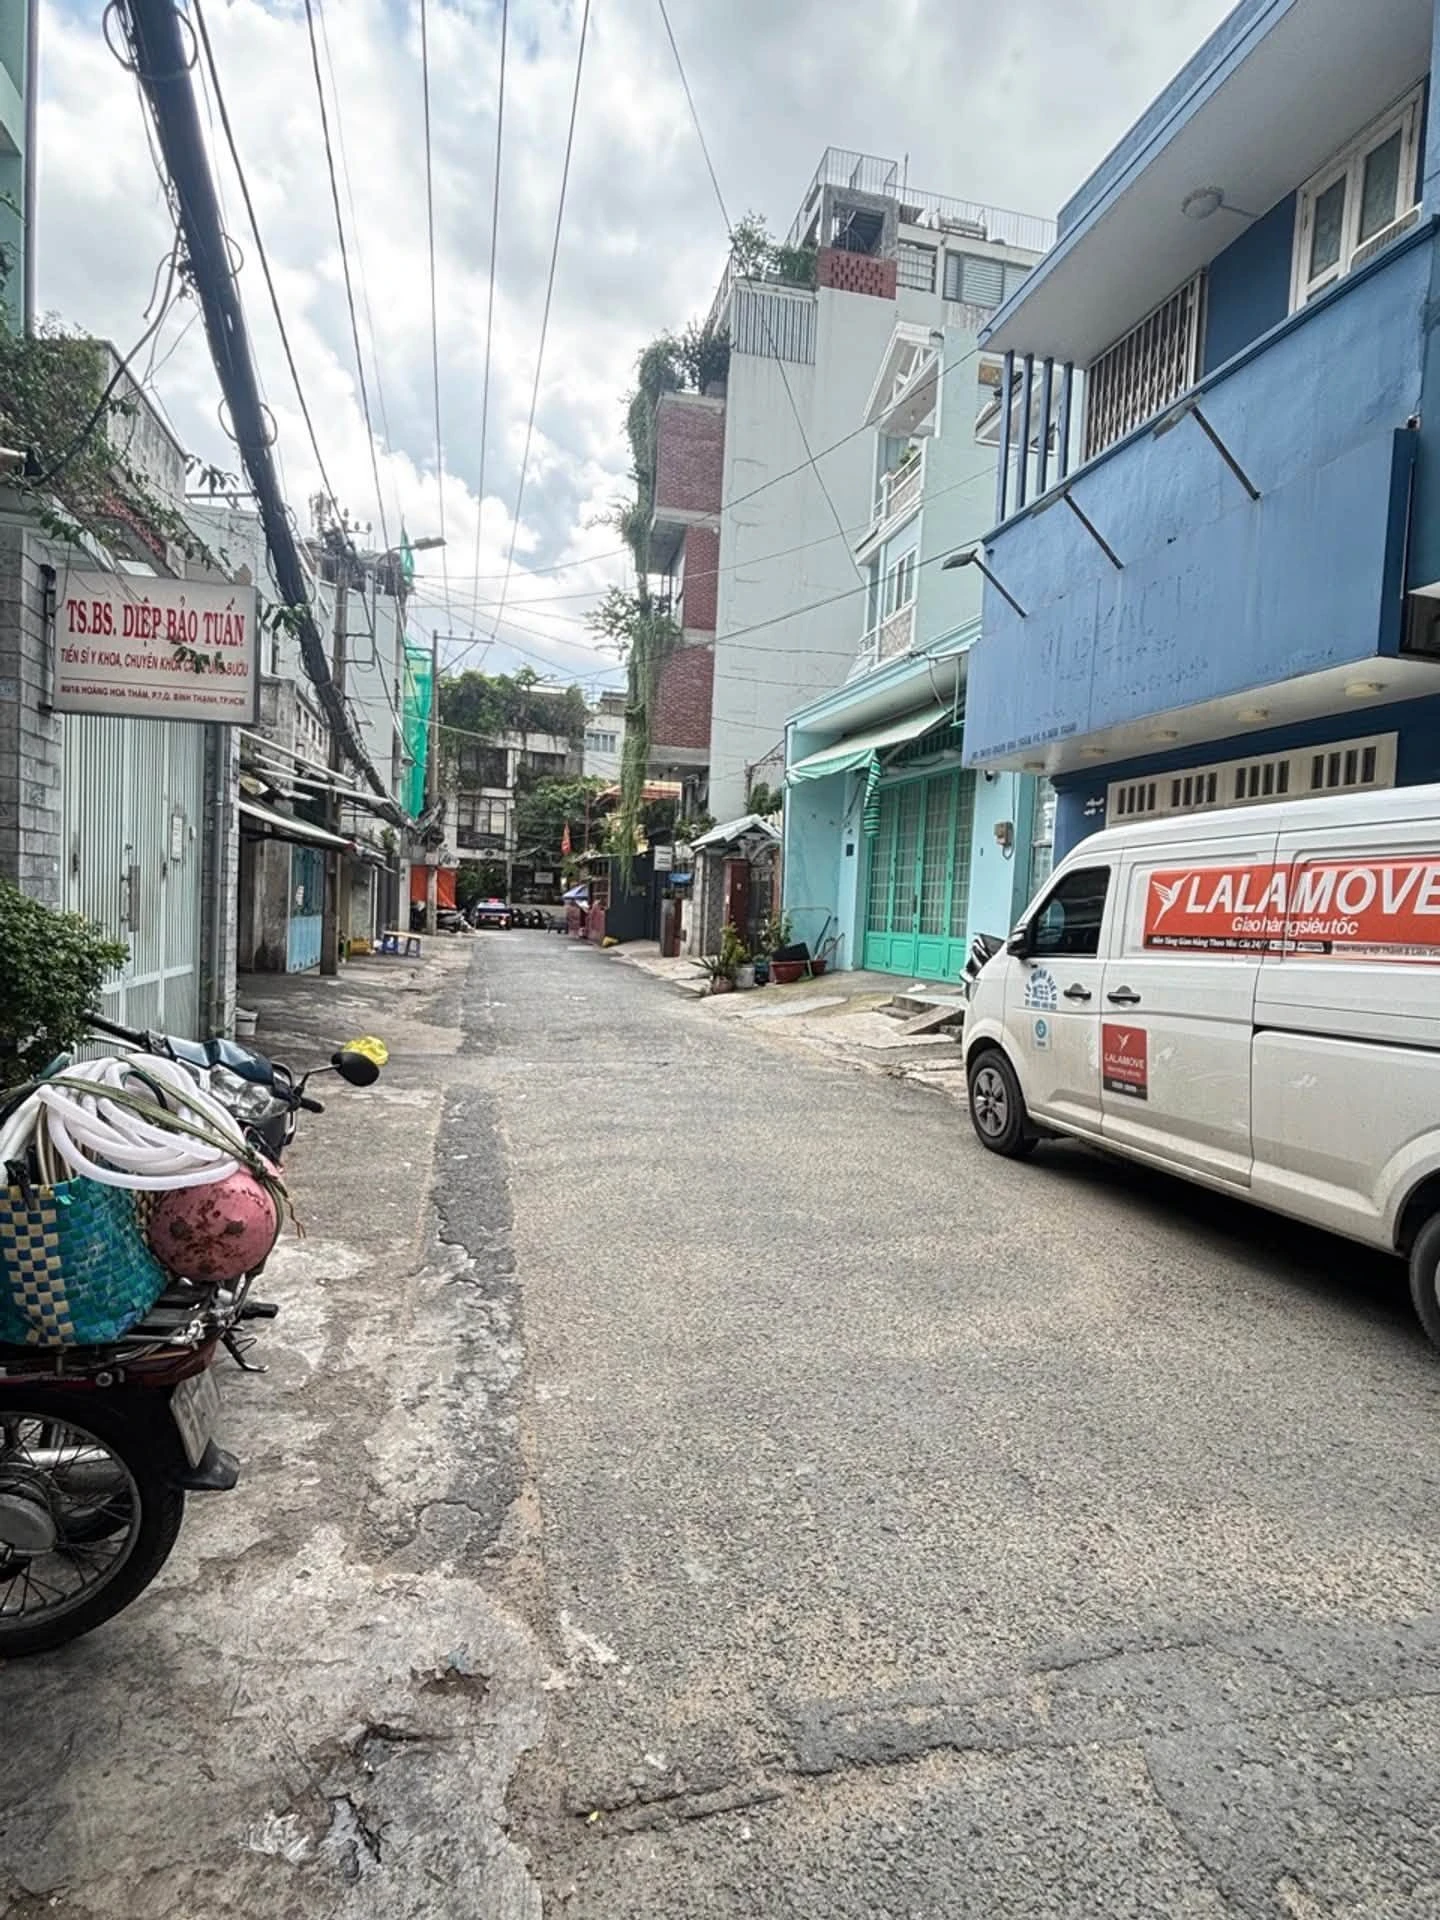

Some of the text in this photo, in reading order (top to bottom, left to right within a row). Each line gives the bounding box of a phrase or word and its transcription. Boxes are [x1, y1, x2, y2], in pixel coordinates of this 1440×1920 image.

[66, 595, 245, 648] TS.BS. DIỆP BẢO TUẤN
[61, 643, 79, 663] TIẾN
[91, 651, 97, 665] Y
[98, 651, 123, 668] KHOA,
[81, 685, 109, 697] HOÀNG
[110, 687, 126, 698] HOA
[1185, 866, 1440, 916] LALAMOVE
[1231, 916, 1261, 933] Giao
[1331, 914, 1360, 936] tốc
